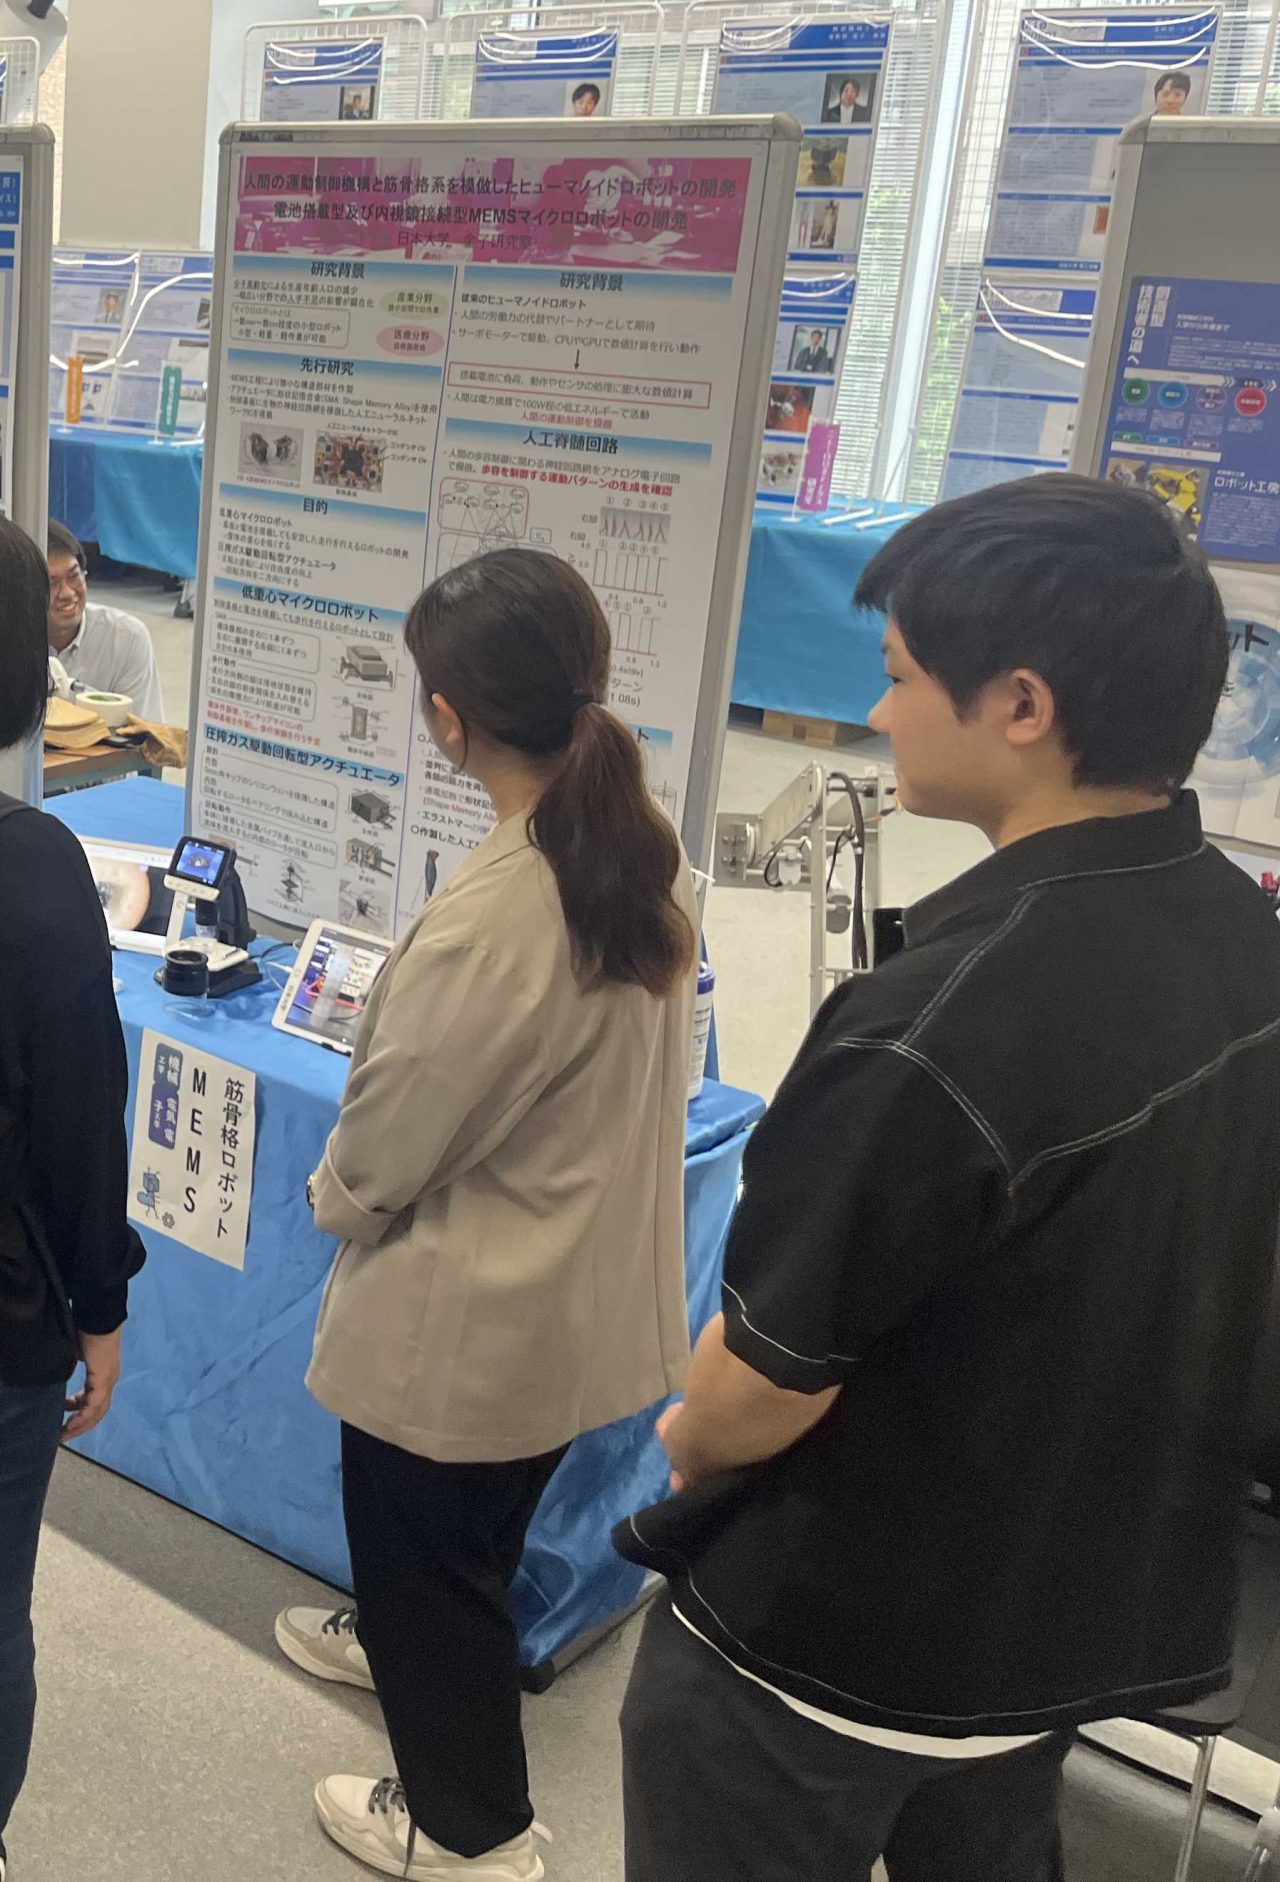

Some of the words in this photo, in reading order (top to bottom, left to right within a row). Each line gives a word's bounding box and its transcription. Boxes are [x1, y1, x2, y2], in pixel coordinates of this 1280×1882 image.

[274, 202, 688, 229] 電池搭載型及び内視鏡接続型MEMSマイクロロボットの開発
[310, 261, 365, 279] 研究背景
[560, 272, 623, 292] 研究背景
[461, 293, 587, 310] 従来のヒューマノイドロボット
[300, 358, 354, 376] 先行研究
[523, 429, 618, 455] 人工脊髄回路
[303, 498, 328, 515] 目的
[241, 585, 379, 623] 低重心マイクロロボット
[205, 726, 401, 787] 圧搾ガス駆動回転型アクチュエータ
[183, 1067, 207, 1214] MEMS
[217, 1078, 245, 1239] 筋骨格ロボット
